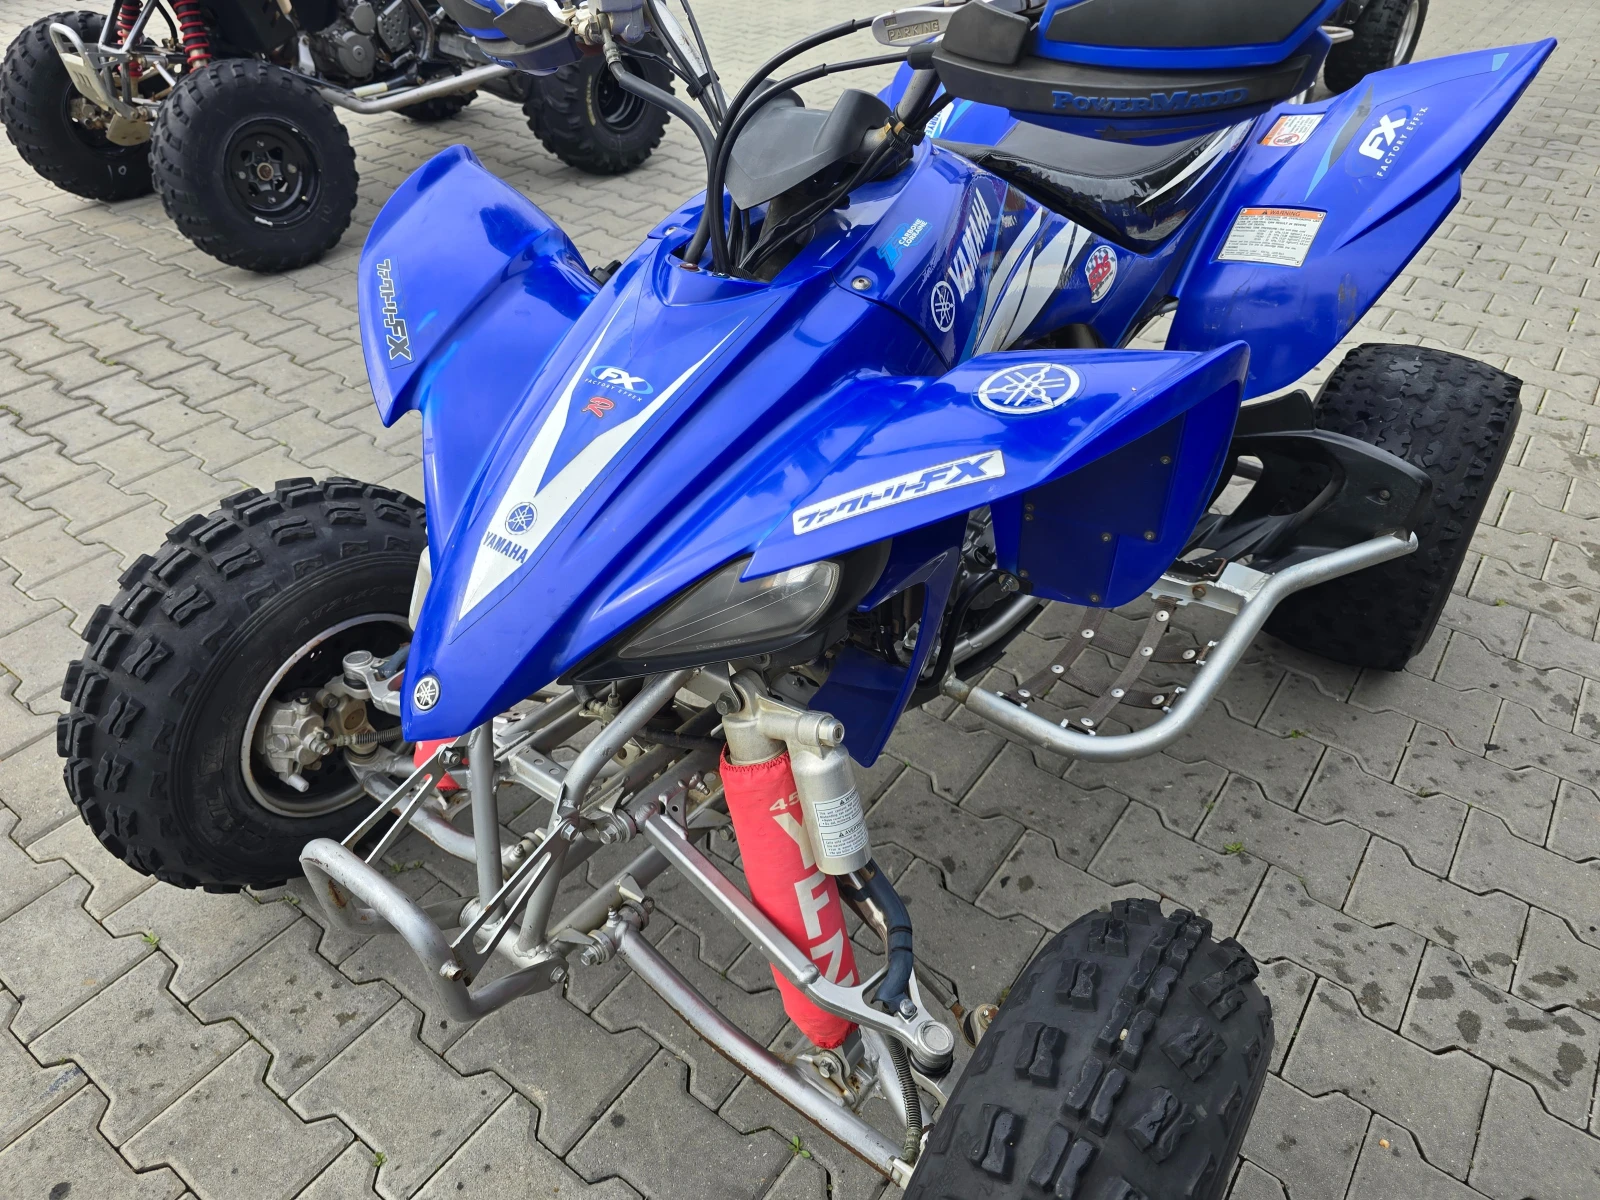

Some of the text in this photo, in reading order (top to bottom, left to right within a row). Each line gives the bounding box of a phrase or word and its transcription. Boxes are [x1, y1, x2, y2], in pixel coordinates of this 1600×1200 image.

[888, 20, 939, 40] PARKING
[1358, 114, 1407, 161] FX
[1376, 133, 1408, 178] FACTORY
[898, 218, 922, 245] CARBONE
[903, 220, 928, 247] LORRAINE
[948, 187, 992, 303] YAMAHA
[584, 378, 643, 403] FACTORY EFFEX
[597, 367, 646, 391] FX
[482, 531, 529, 564] YAMAHA
[769, 791, 800, 811] 45
